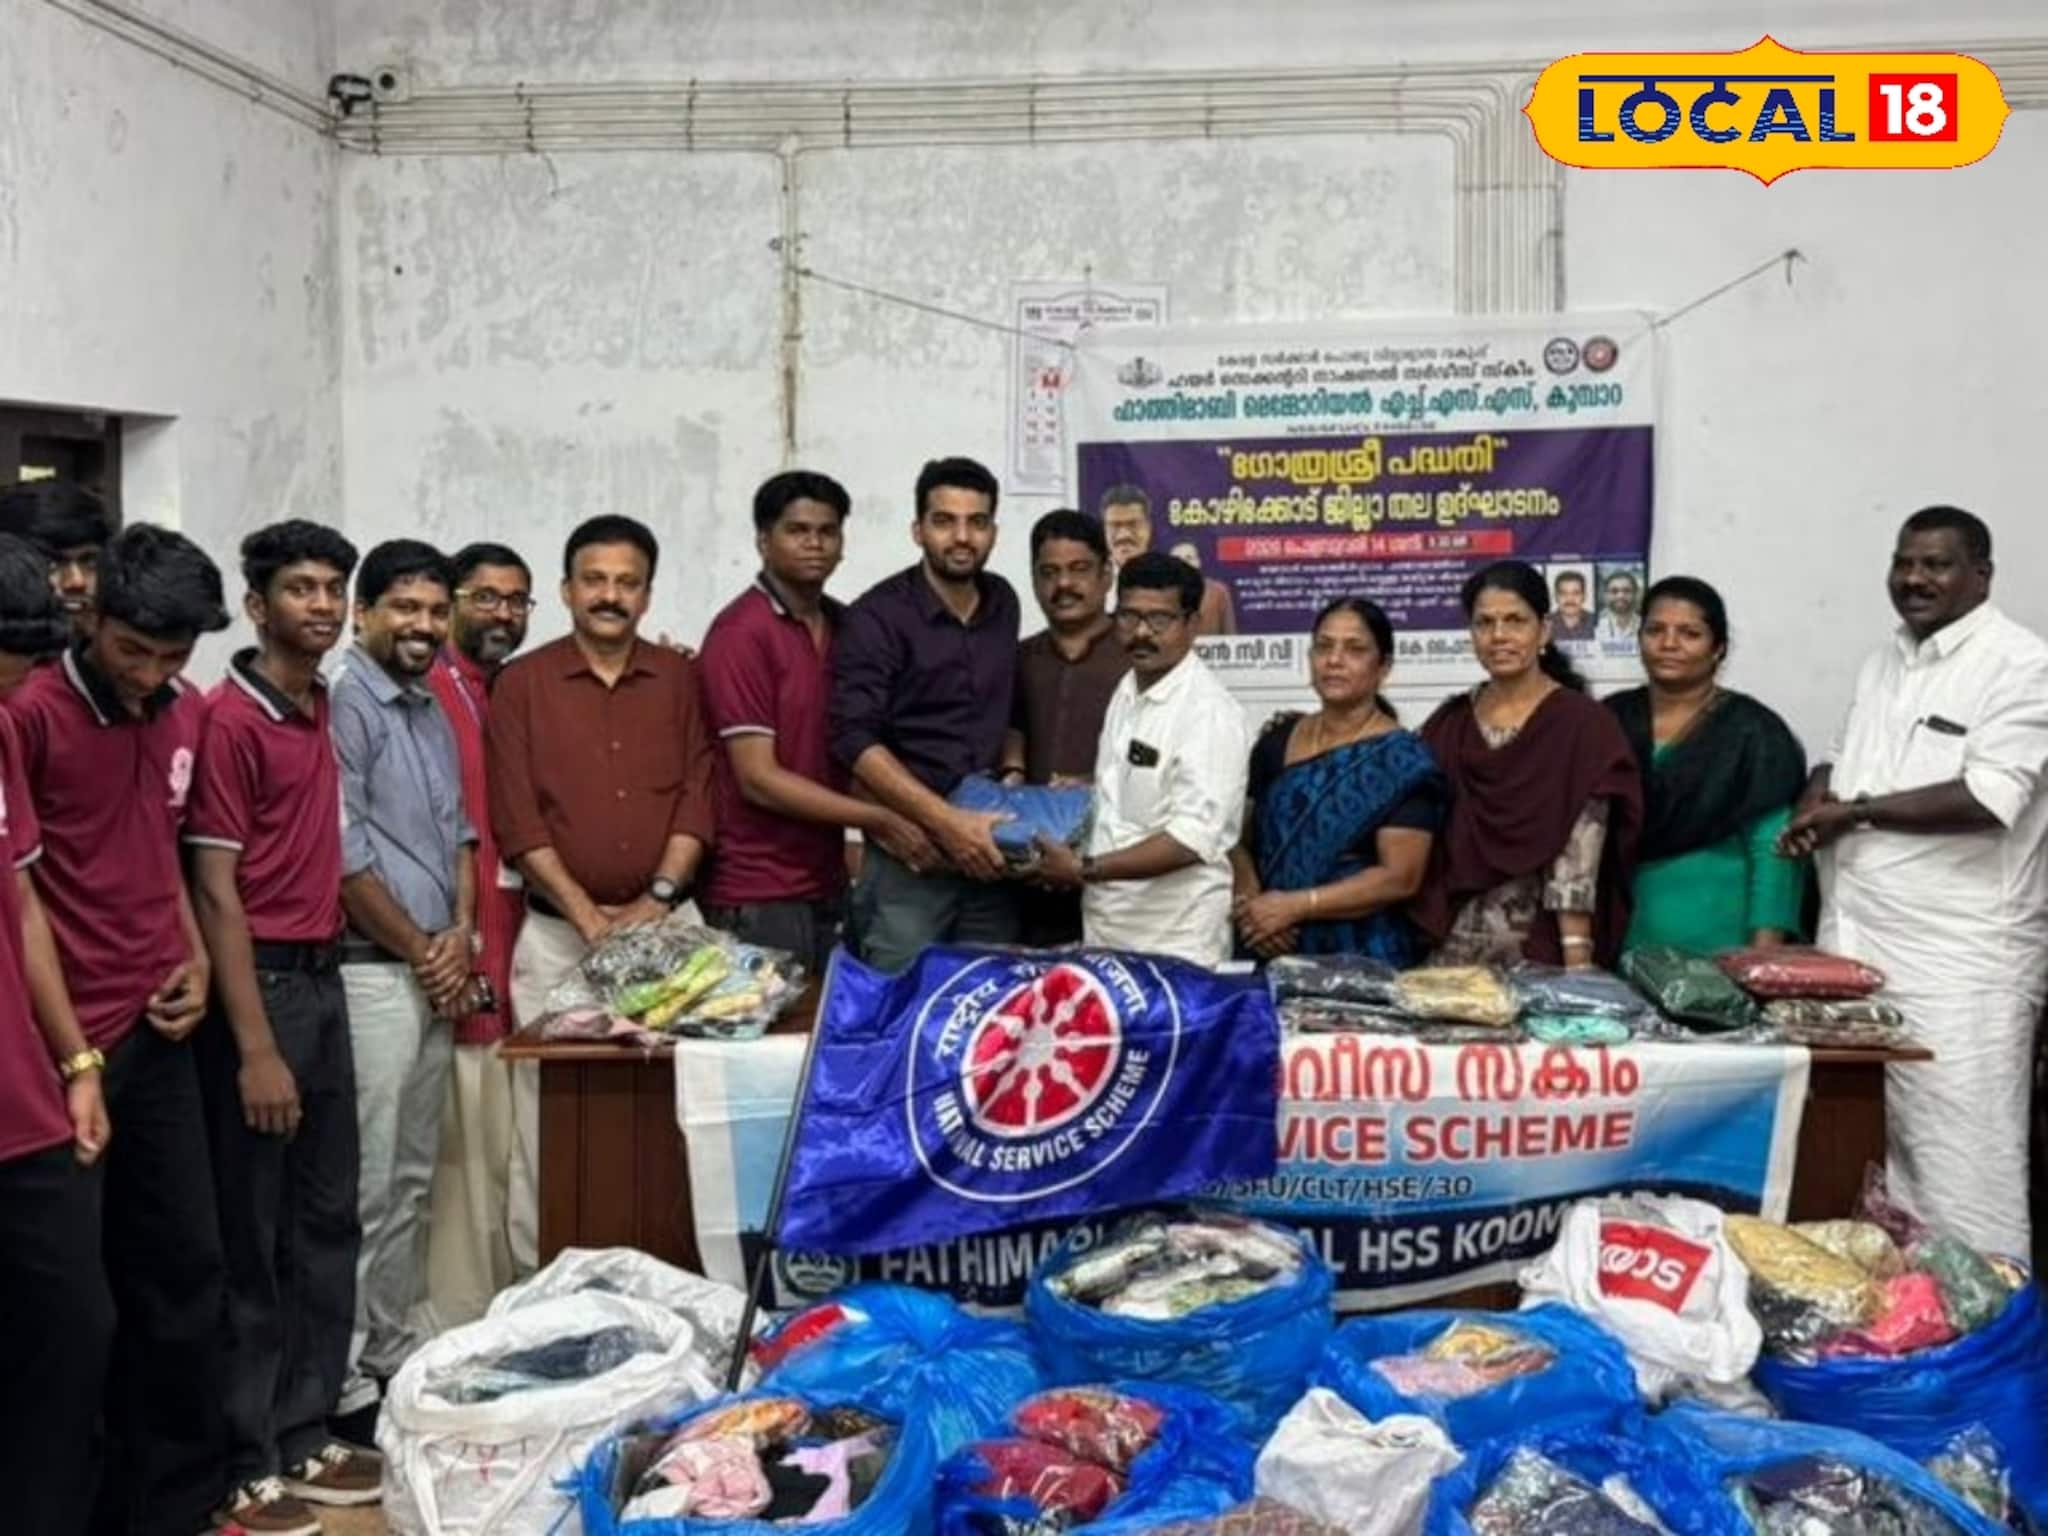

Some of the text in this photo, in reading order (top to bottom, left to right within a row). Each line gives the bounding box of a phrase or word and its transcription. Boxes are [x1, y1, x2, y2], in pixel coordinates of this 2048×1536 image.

[1168, 484, 1321, 527] കോഴിക്കോട്
[1323, 483, 1384, 532] ജില്ലാ
[1387, 491, 1433, 521] തല
[988, 1126, 1086, 1172] SERVICE
[1083, 1048, 1150, 1139] SCHEME
[1276, 1111, 1634, 1161] VICE SCHEME
[1202, 1174, 1473, 1200] /SFU/CLT/HSE/30
[1358, 1226, 1439, 1273] HSS
